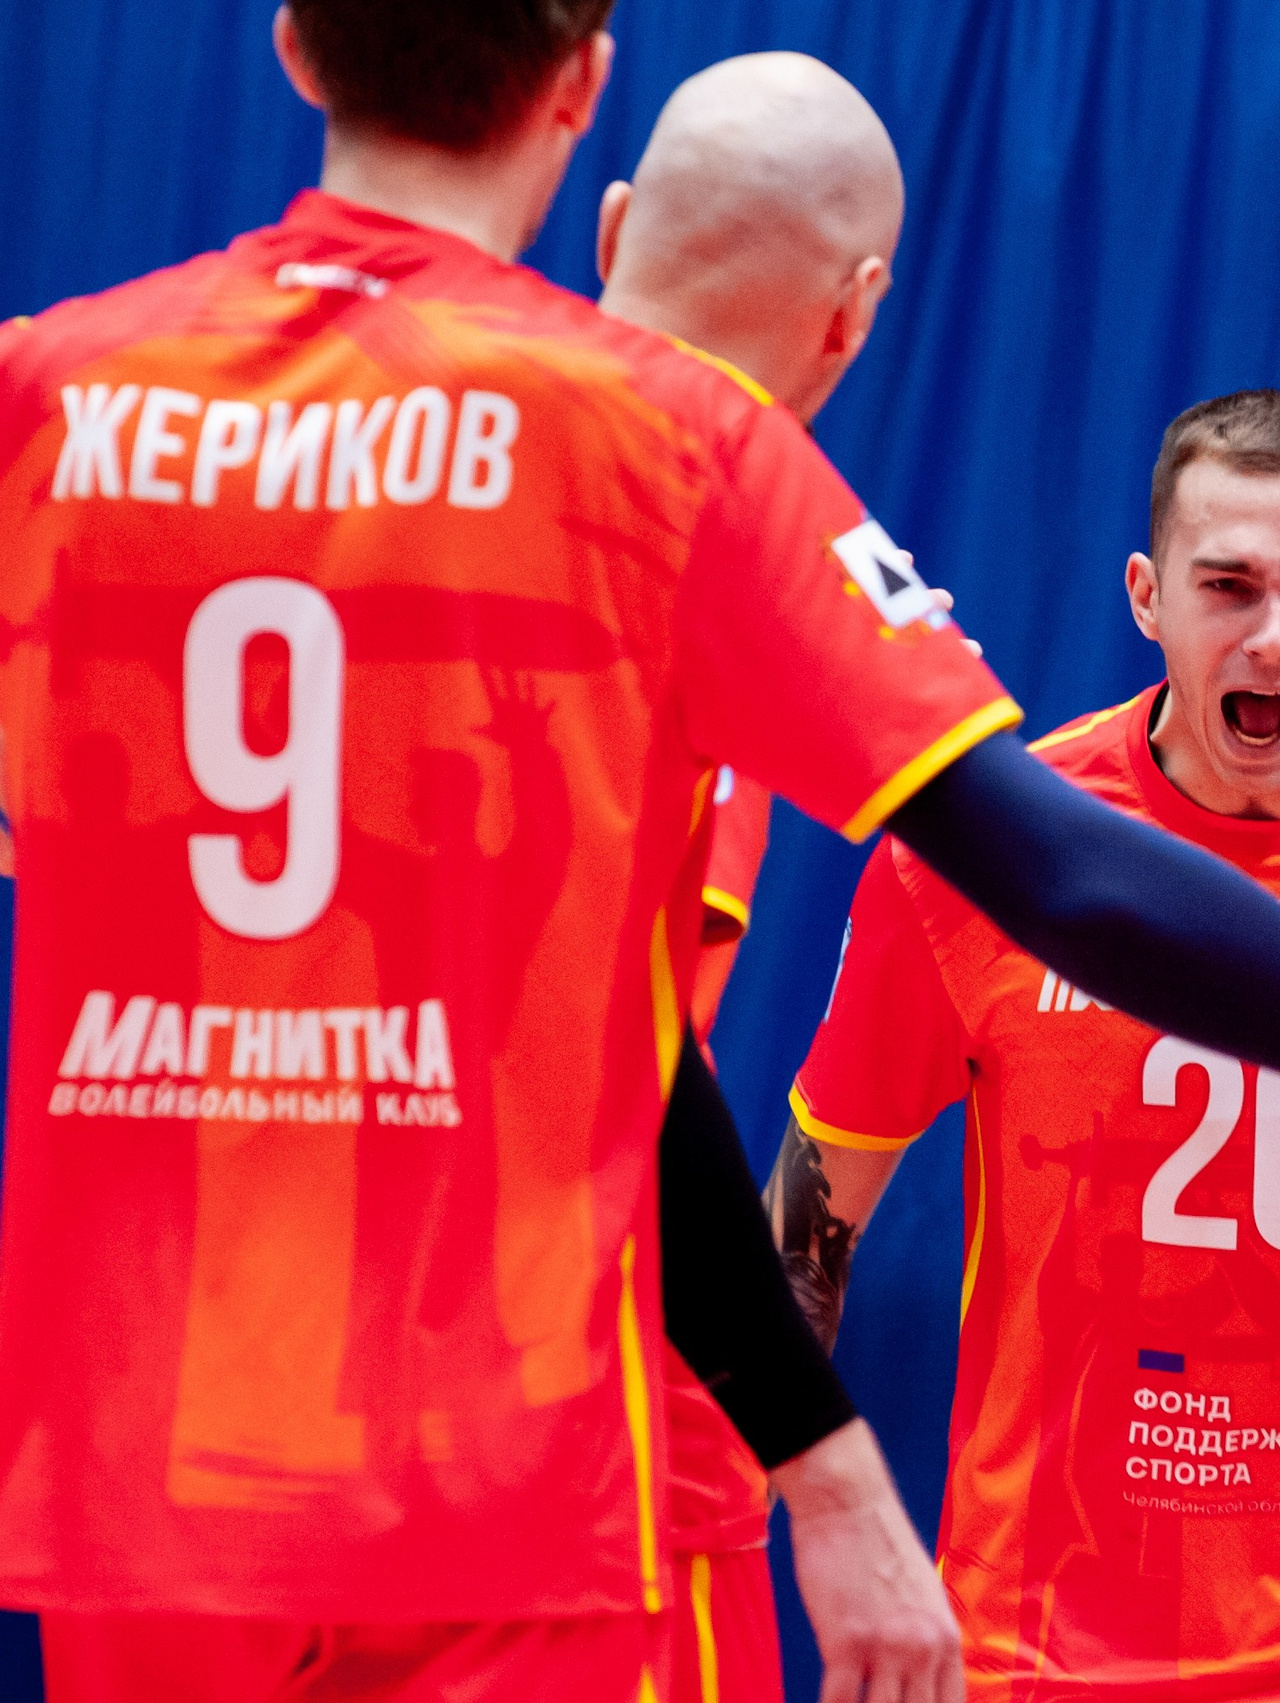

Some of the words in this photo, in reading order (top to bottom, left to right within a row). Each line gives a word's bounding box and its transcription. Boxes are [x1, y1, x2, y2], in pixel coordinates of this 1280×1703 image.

[51, 384, 520, 509] ЖЕРИКОВ
[183, 576, 345, 941] 9
[57, 989, 456, 1089] МАГНИТКА
[47, 1080, 364, 1124] ВОЛЕЙБОЛЬНЫЙ
[376, 1092, 462, 1127] КЛУБ
[1133, 1387, 1232, 1423] ФОНД
[1125, 1456, 1251, 1486] СПОРТА
[1122, 1490, 1244, 1515] Челябинской
